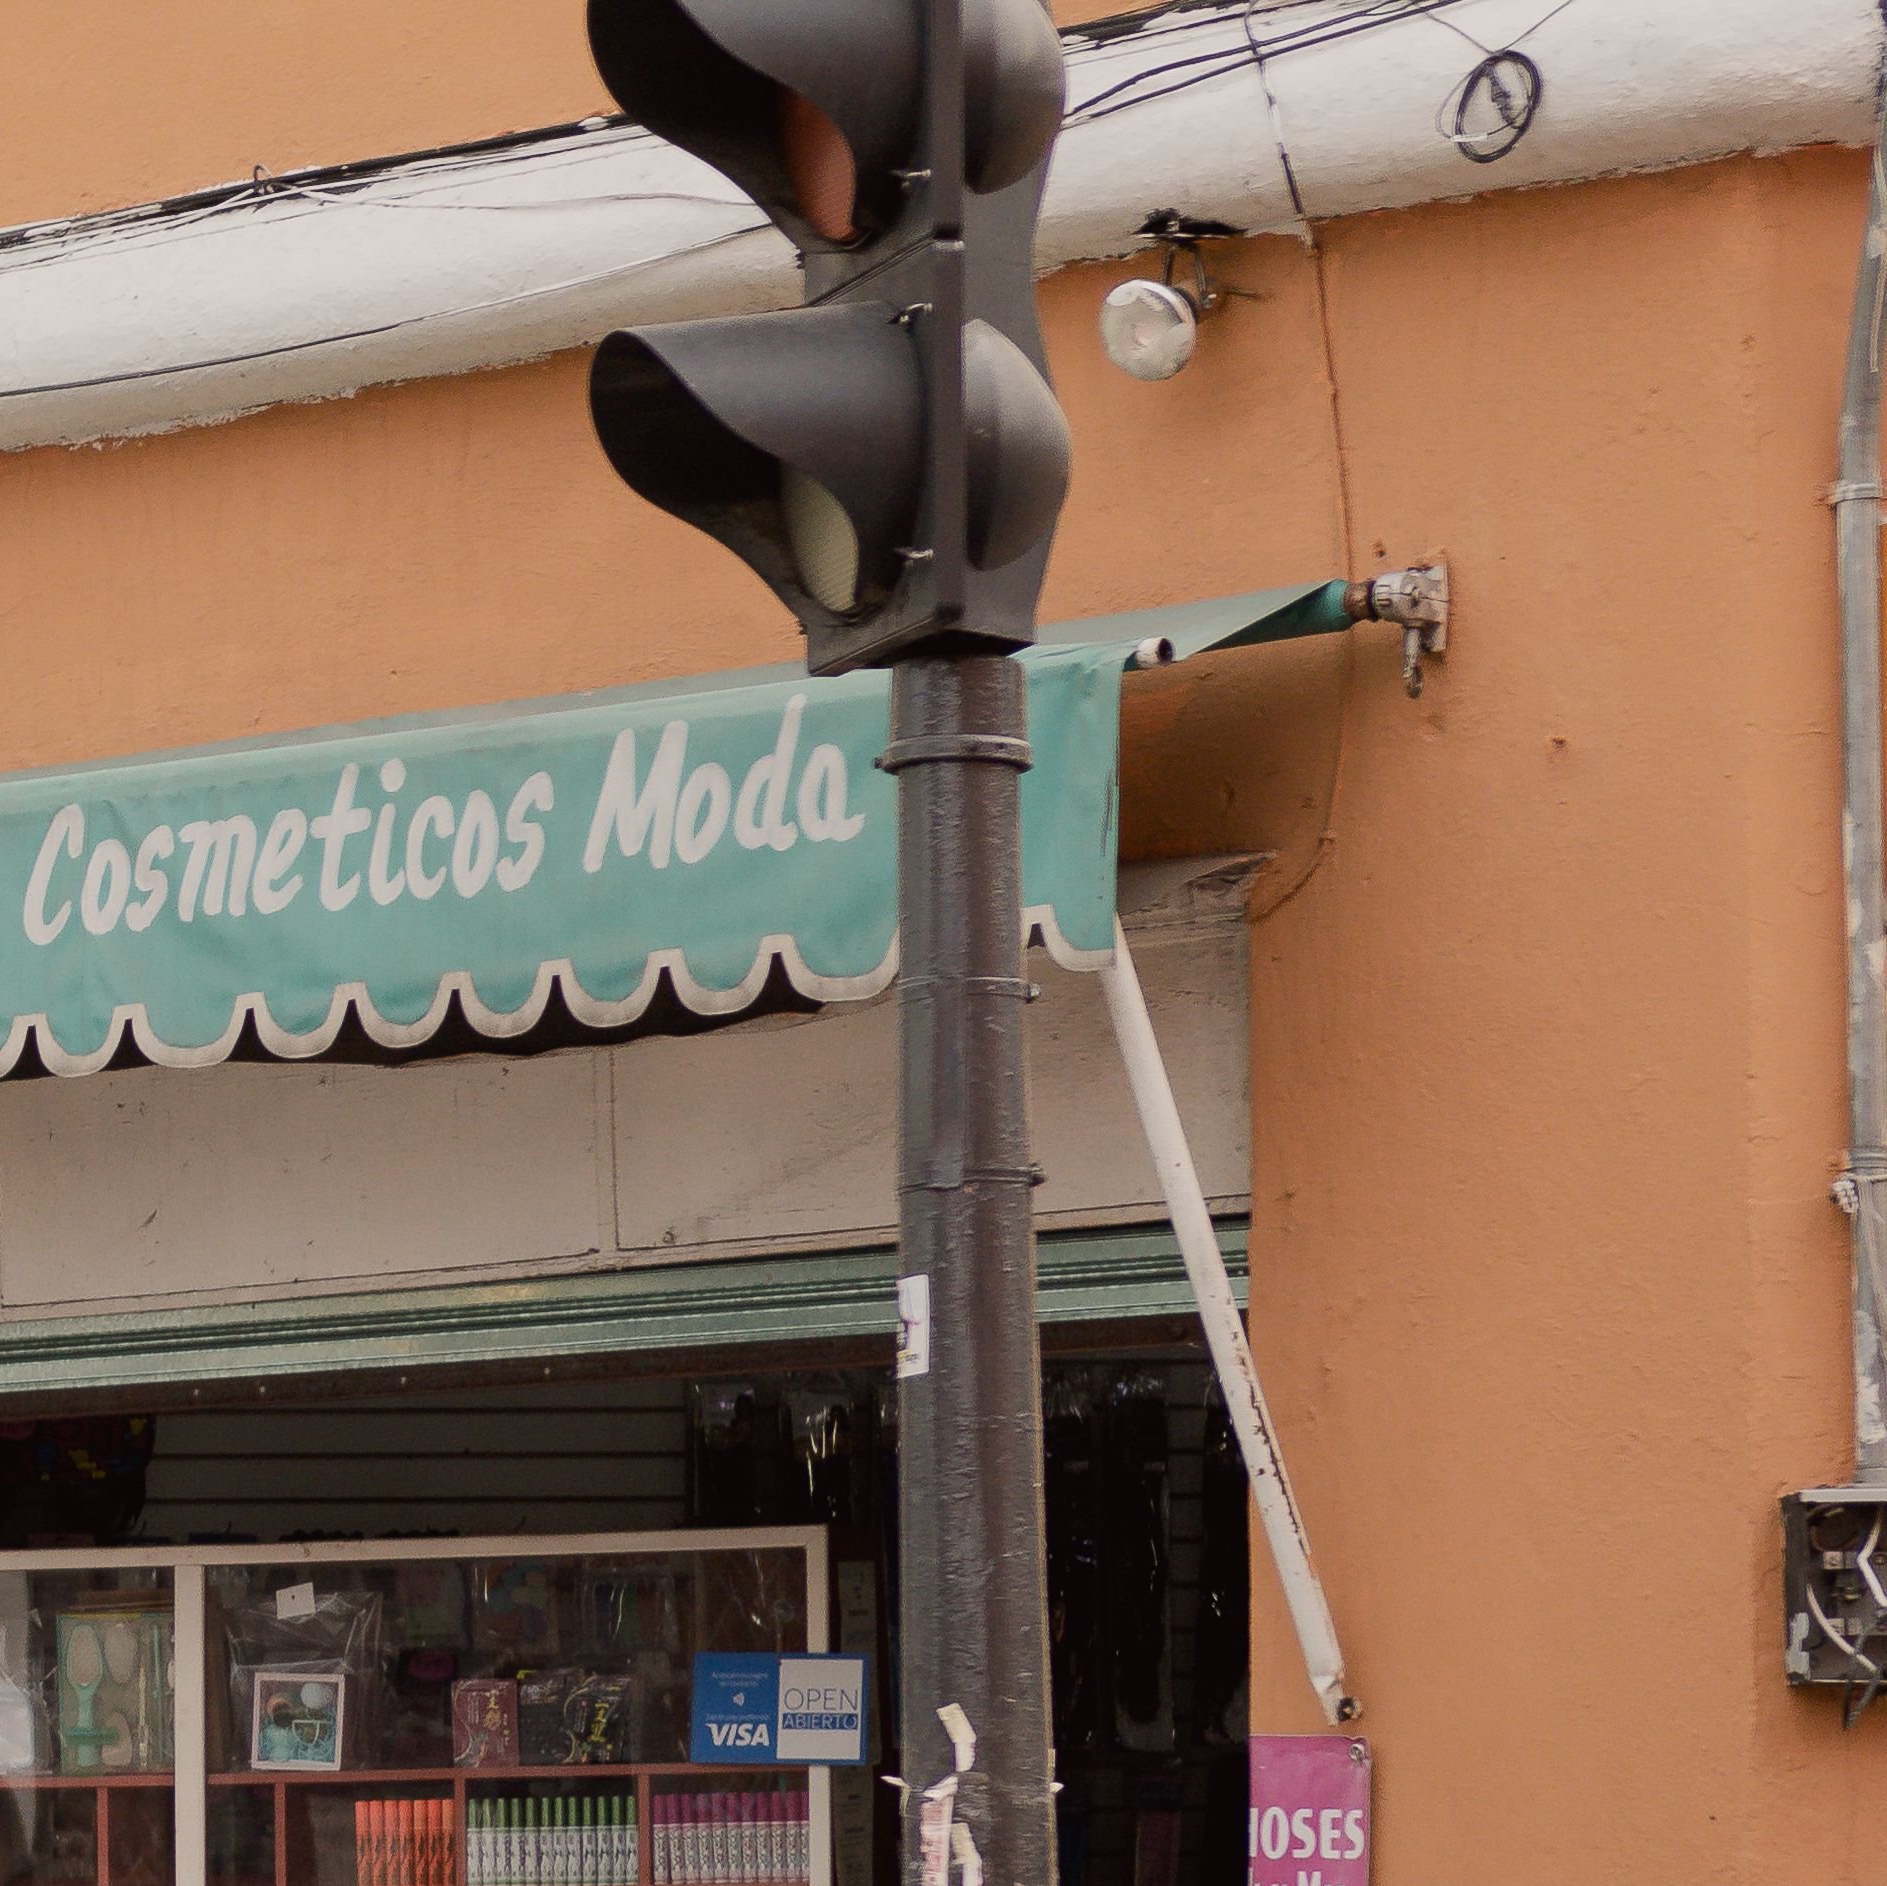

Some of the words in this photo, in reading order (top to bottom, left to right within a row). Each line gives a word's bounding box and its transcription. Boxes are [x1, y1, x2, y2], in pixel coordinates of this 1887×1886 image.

[24, 758, 554, 945] Cosmeticos
[582, 694, 865, 873] Moda
[783, 1688, 859, 1711] OPEN
[783, 1714, 859, 1730] ABIERTO
[706, 1723, 770, 1746] VISA
[1249, 1807, 1365, 1860] OSES
